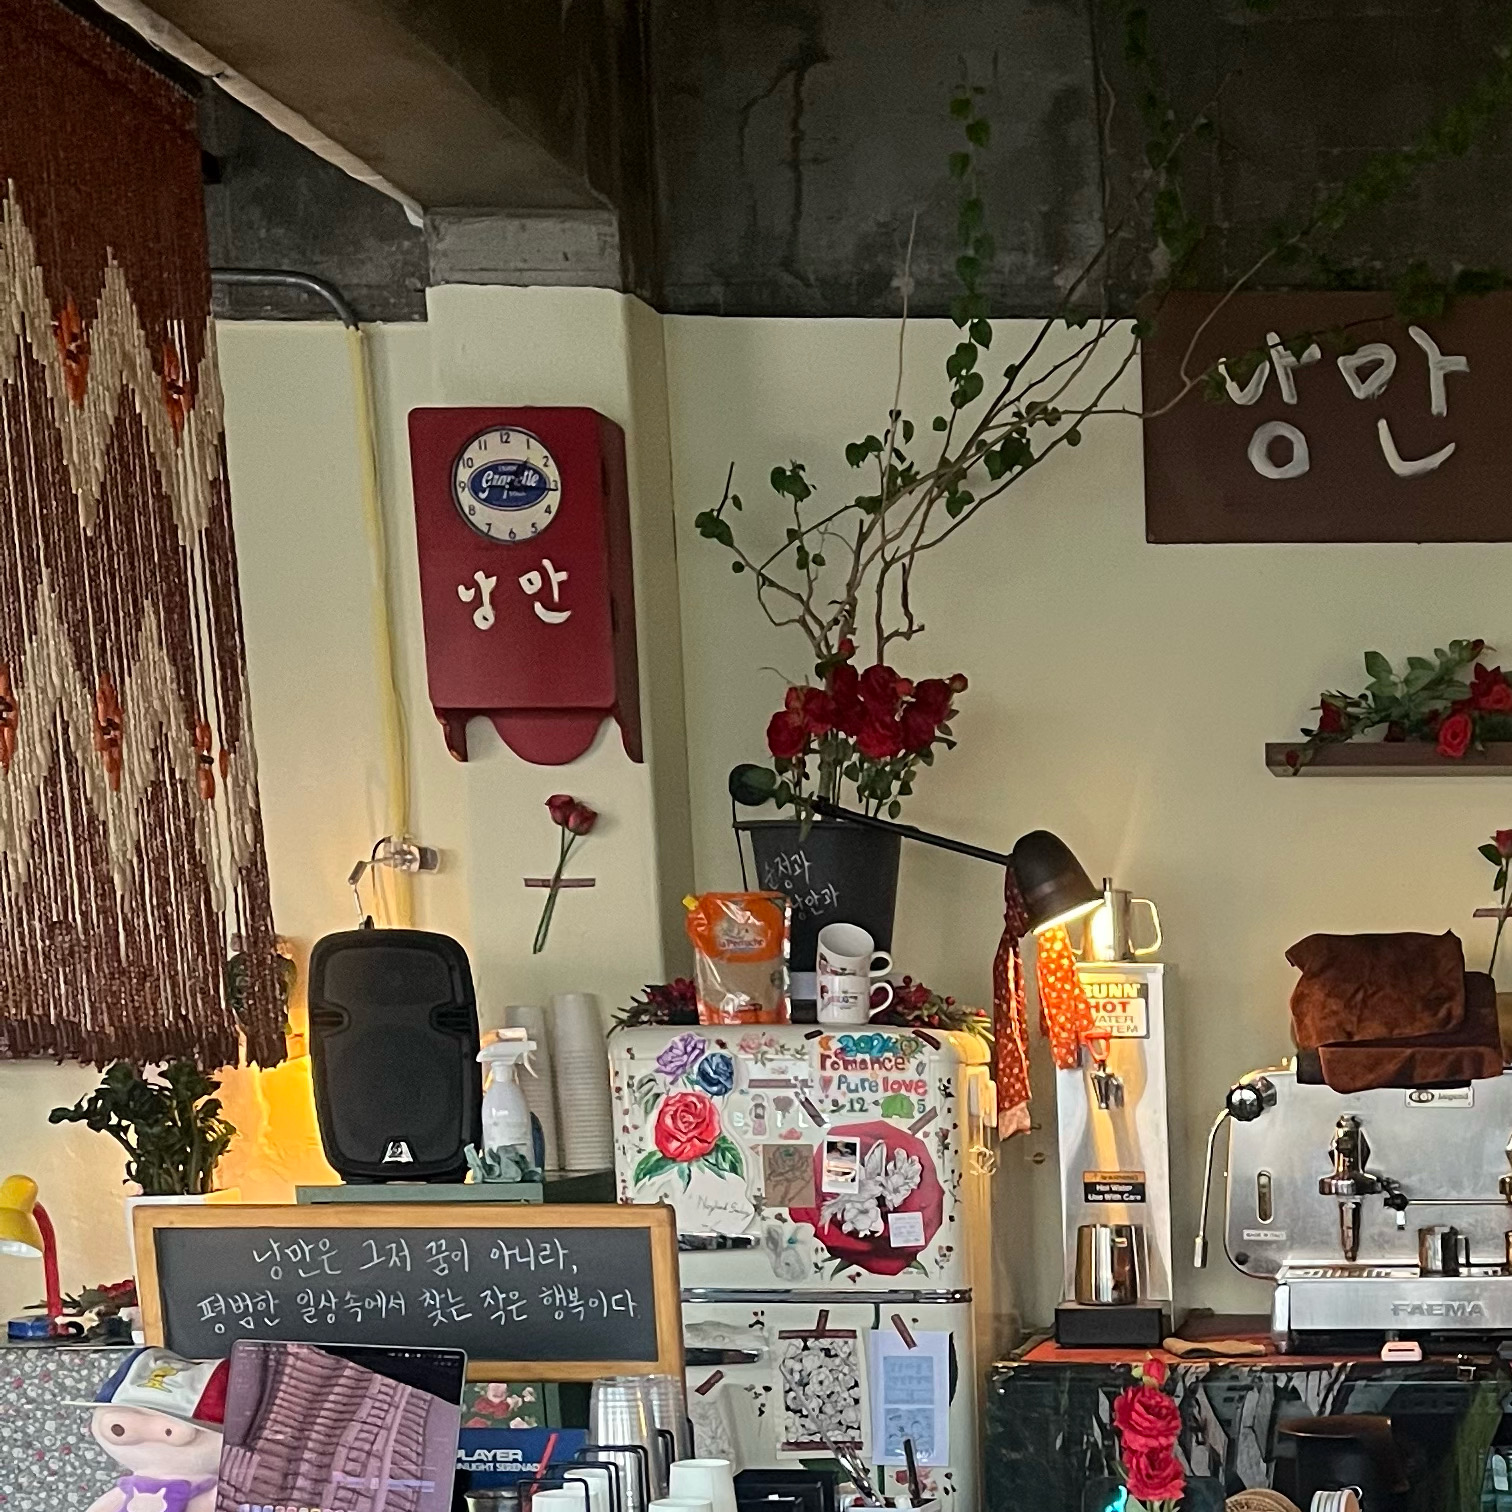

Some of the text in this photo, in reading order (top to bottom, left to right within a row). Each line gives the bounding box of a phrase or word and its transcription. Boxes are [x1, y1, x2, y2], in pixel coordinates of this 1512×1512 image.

[1216, 325, 1470, 480] 낭만
[500, 432, 511, 444] 12
[478, 439, 487, 451] 11
[462, 457, 474, 469] 10
[542, 456, 549, 467] 2
[458, 481, 467, 493] 9
[468, 504, 476, 516] 8
[544, 504, 552, 515] 4
[485, 523, 492, 534] 7
[509, 528, 516, 540] 6
[531, 522, 538, 534] 5
[765, 850, 813, 890] 순정과
[820, 1052, 905, 1072] romance
[837, 1074, 928, 1097] Pure love
[251, 1236, 580, 1280] 낭만은 그저 꿈이 아니라,
[196, 1292, 281, 1334] 평범한
[418, 1287, 473, 1327] 찾는
[479, 1284, 528, 1326] 작은
[1391, 1303, 1486, 1317] FAEMA
[496, 1463, 540, 1472] SERENAD
